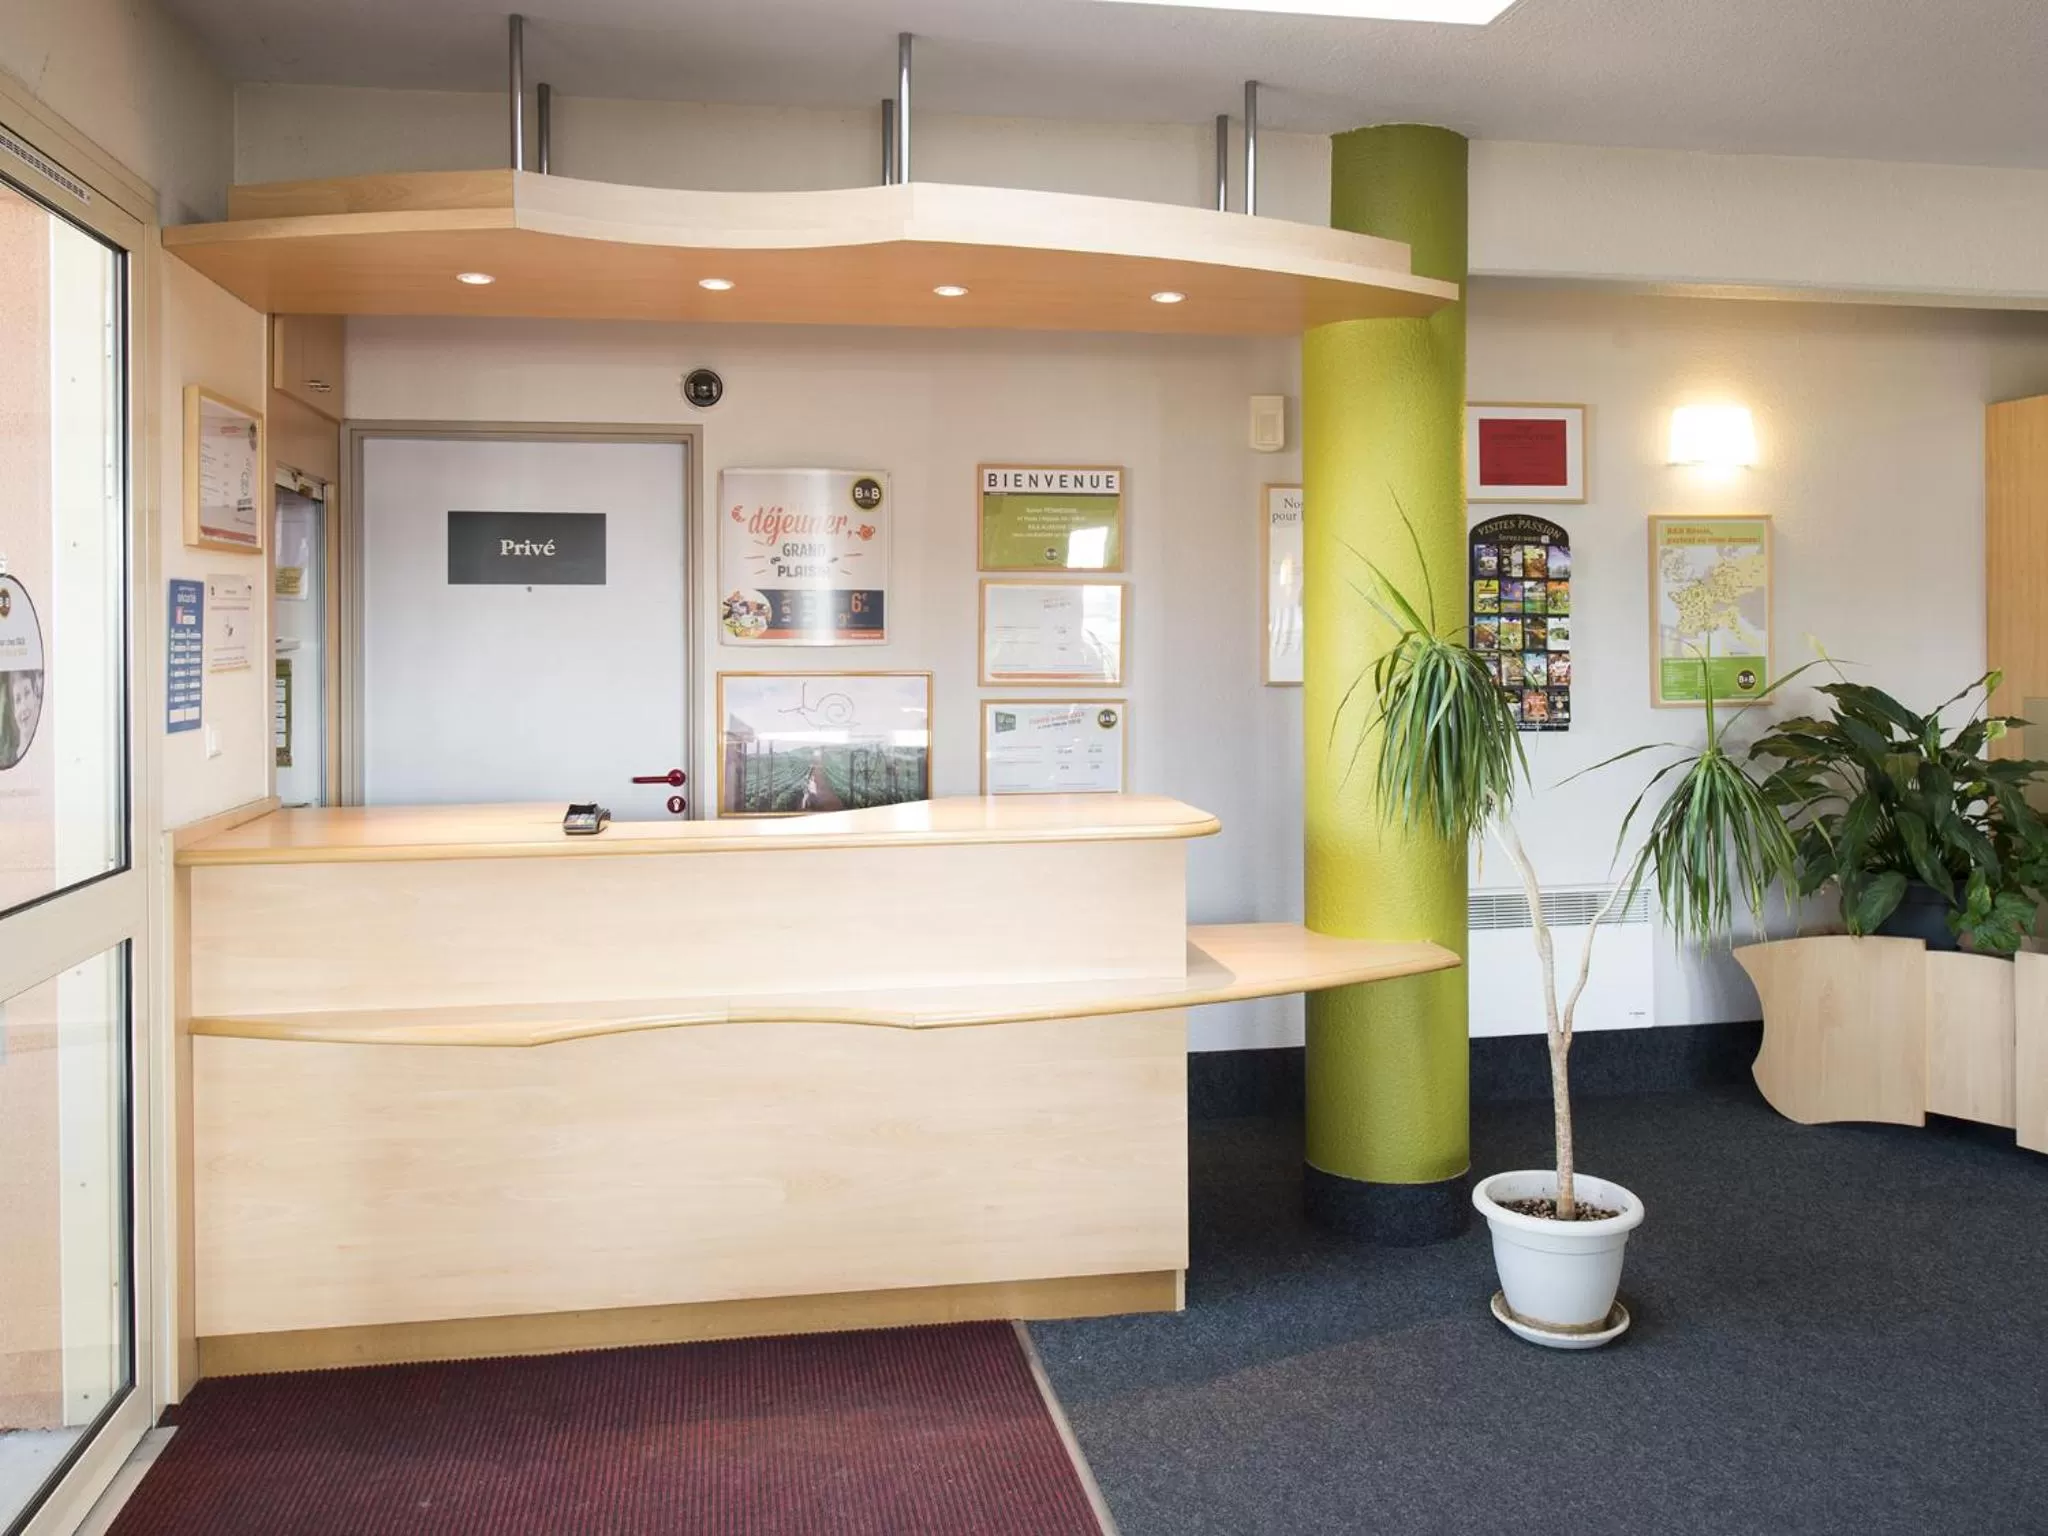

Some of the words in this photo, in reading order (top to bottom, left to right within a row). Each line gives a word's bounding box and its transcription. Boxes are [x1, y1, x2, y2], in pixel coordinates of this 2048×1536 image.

[988, 473, 1115, 489] BIENVENUE
[1272, 513, 1297, 524] pour
[1478, 519, 1516, 535] VISITES
[1518, 519, 1562, 539] PASSION
[500, 539, 556, 556] Privé
[782, 543, 826, 558] GRAND
[777, 565, 830, 578] PLAIS
